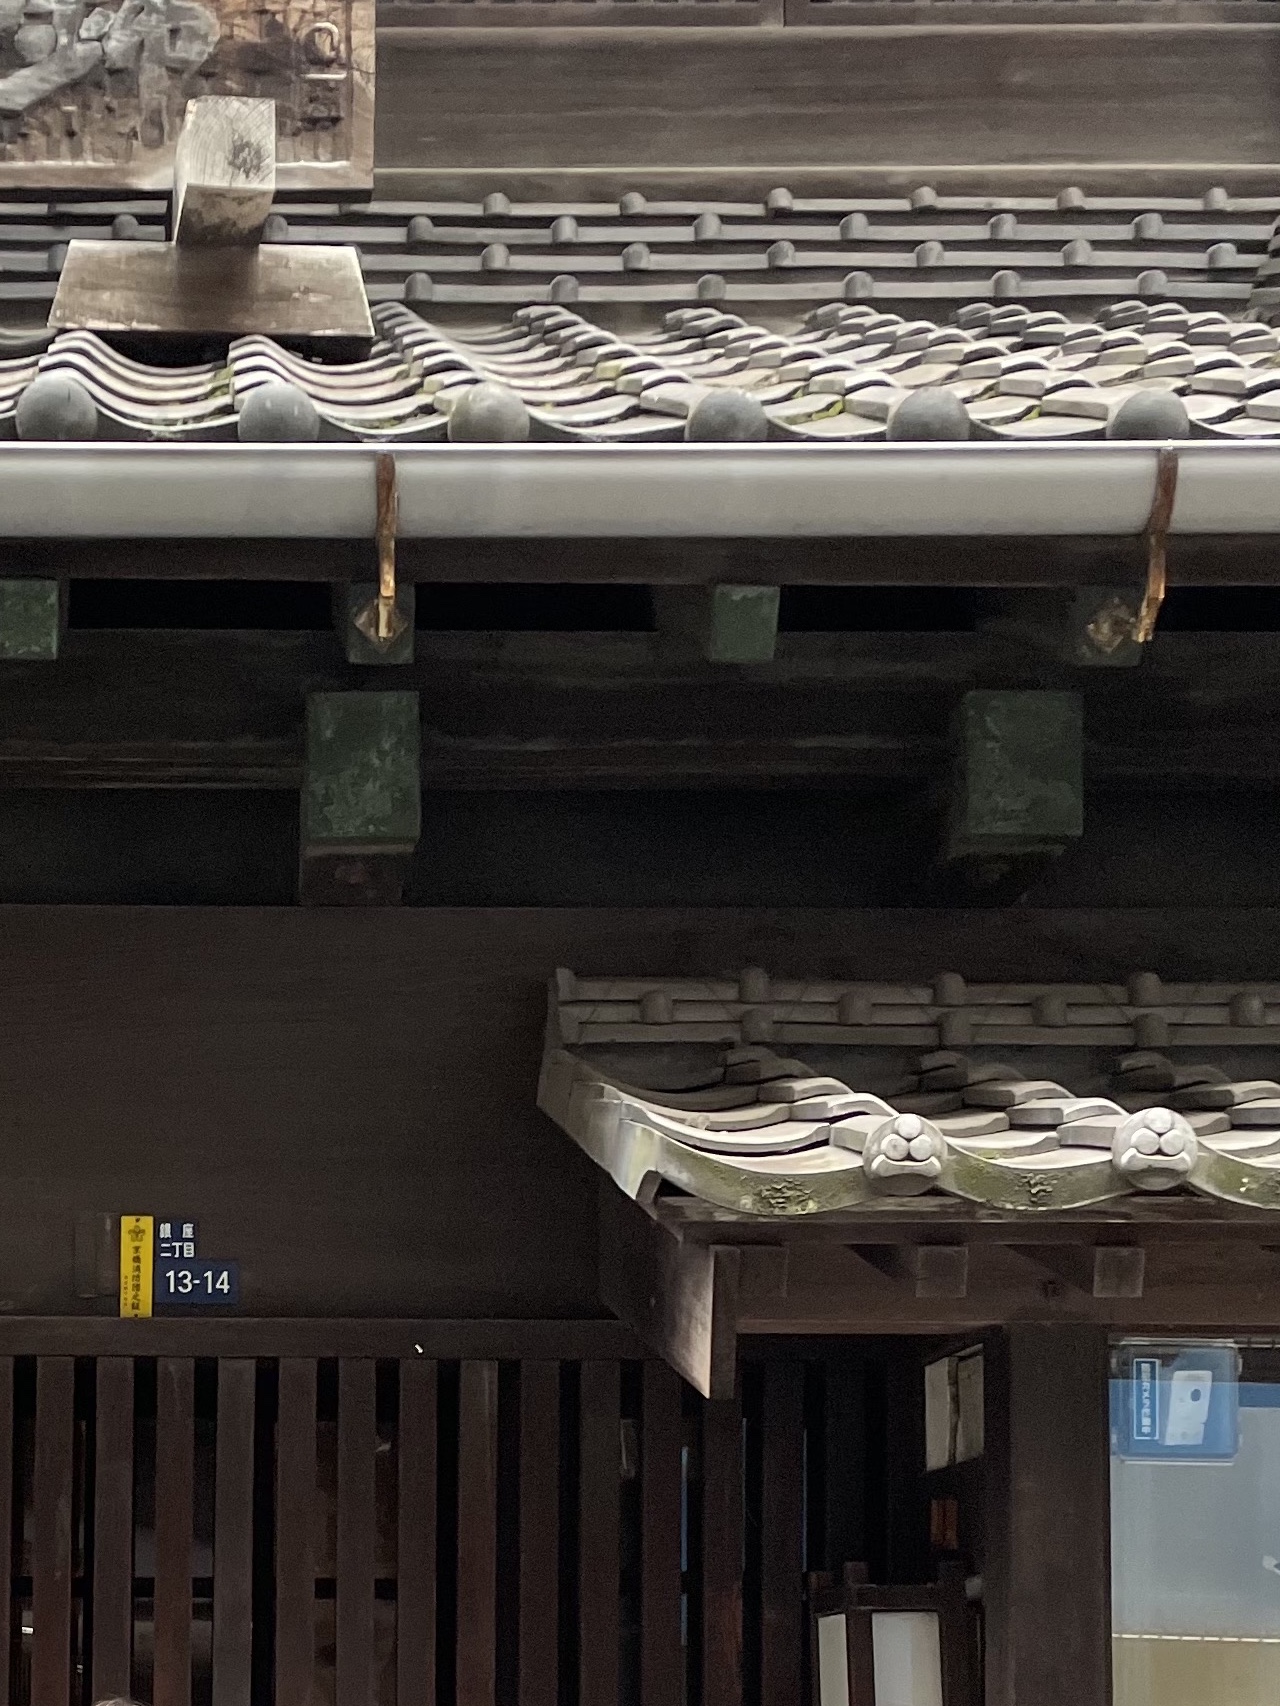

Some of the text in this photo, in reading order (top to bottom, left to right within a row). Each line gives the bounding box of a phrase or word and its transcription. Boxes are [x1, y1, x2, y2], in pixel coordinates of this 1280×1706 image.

[159, 1222, 195, 1239] 銀座
[160, 1241, 195, 1258] 二丁目
[165, 1269, 231, 1294] 13-14
